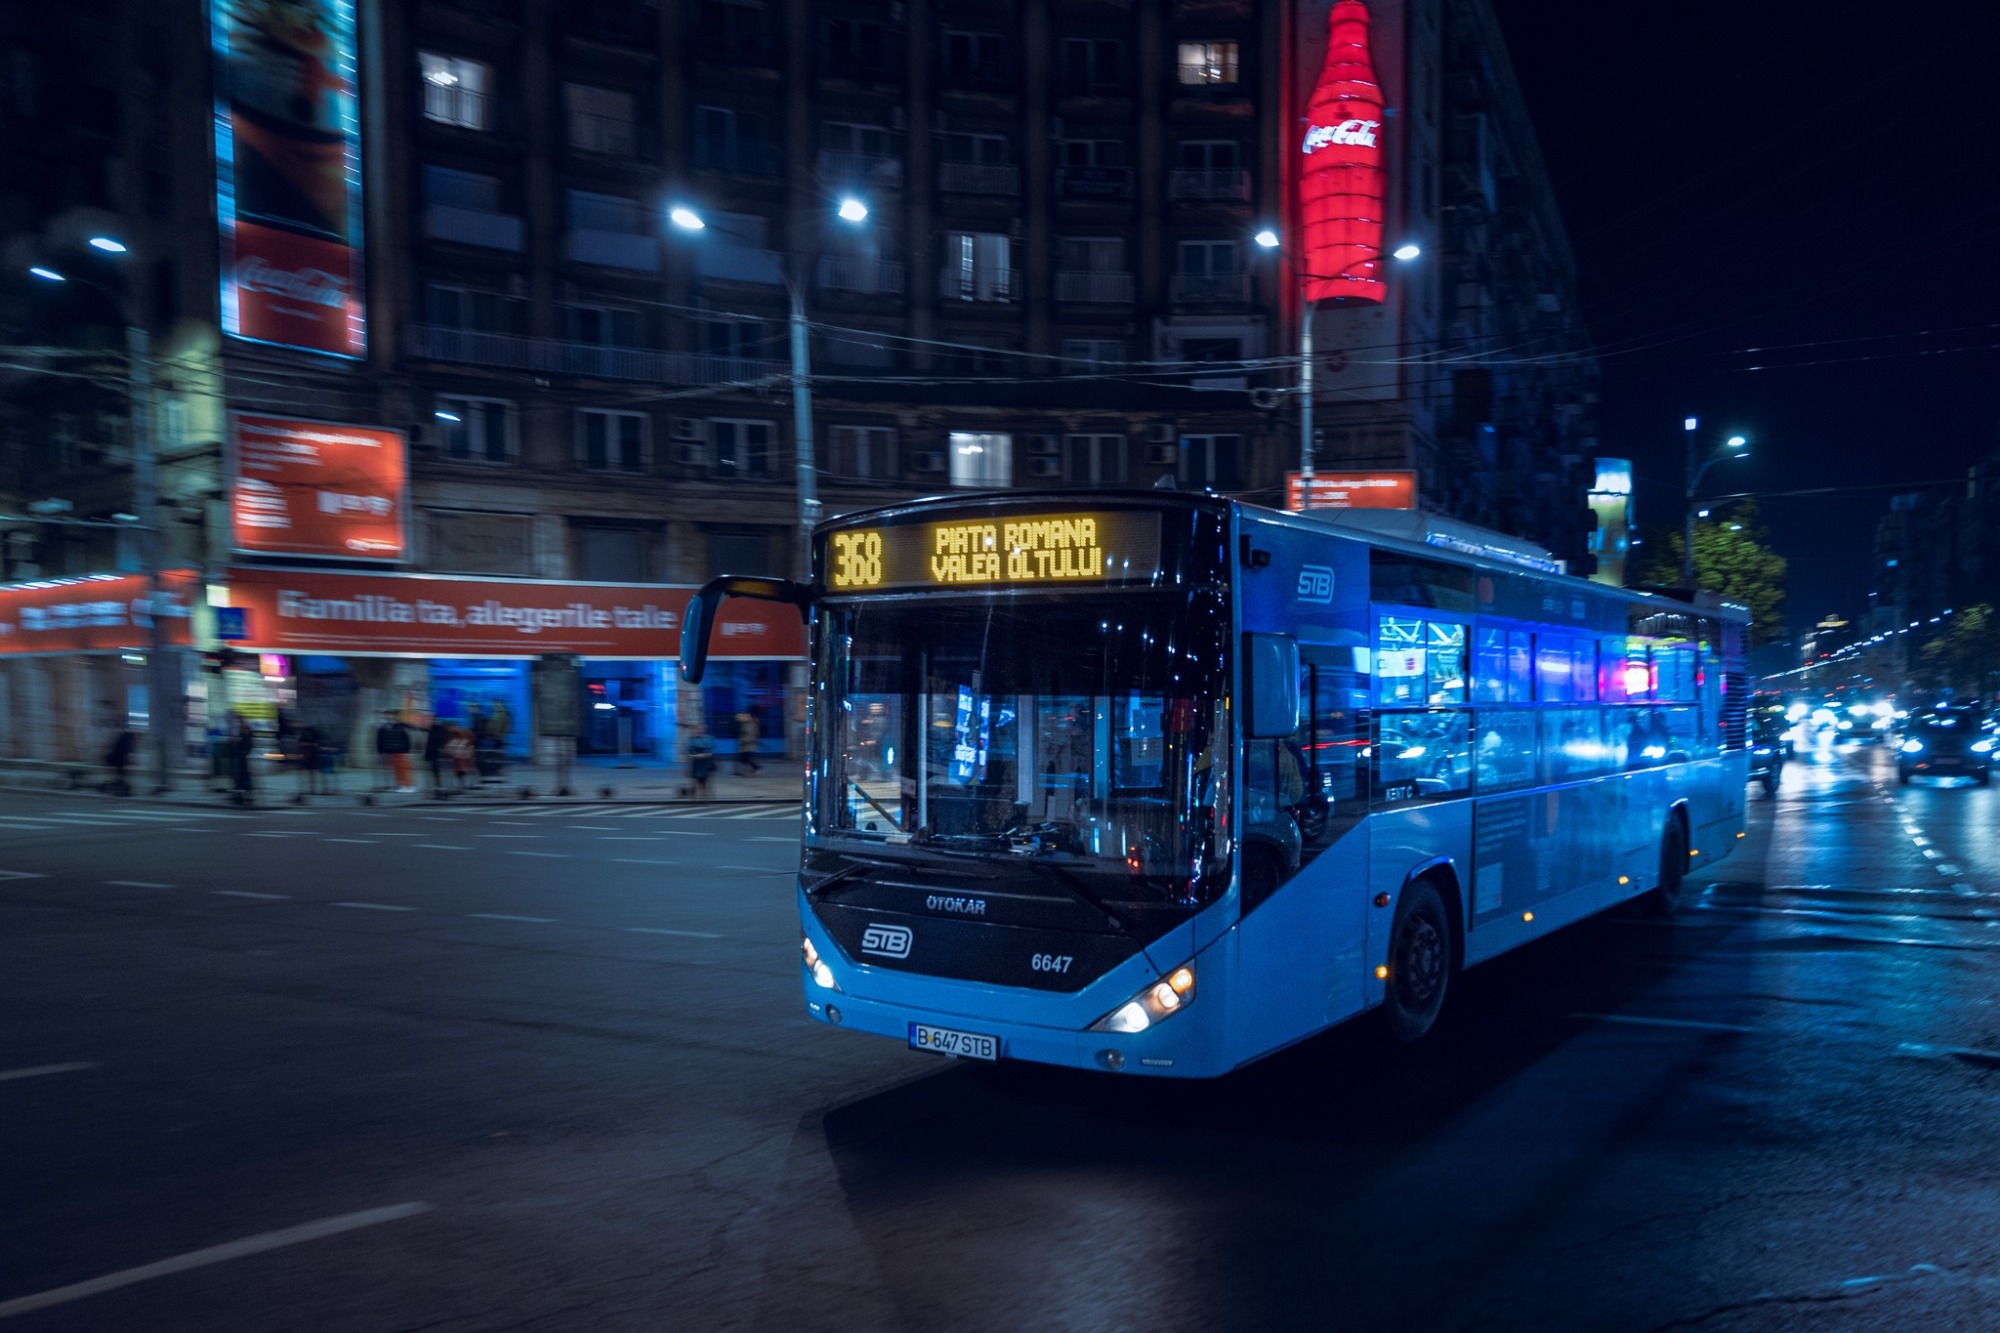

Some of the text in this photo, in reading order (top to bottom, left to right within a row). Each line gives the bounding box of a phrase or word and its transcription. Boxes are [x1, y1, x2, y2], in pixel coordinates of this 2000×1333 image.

[1302, 119, 1381, 154] CaCola
[936, 518, 1096, 554] PIATA ROMANA
[834, 532, 882, 586] 368
[931, 547, 1102, 582] VALEA OLTULUI
[1298, 570, 1332, 596] STB
[276, 589, 417, 623] Familia
[465, 600, 613, 634] alegerile
[613, 604, 679, 629] tale
[926, 895, 987, 915] OTOKAR
[861, 928, 908, 953] STB
[1031, 953, 1073, 974] 6647
[918, 1028, 992, 1057] B 647 STB
